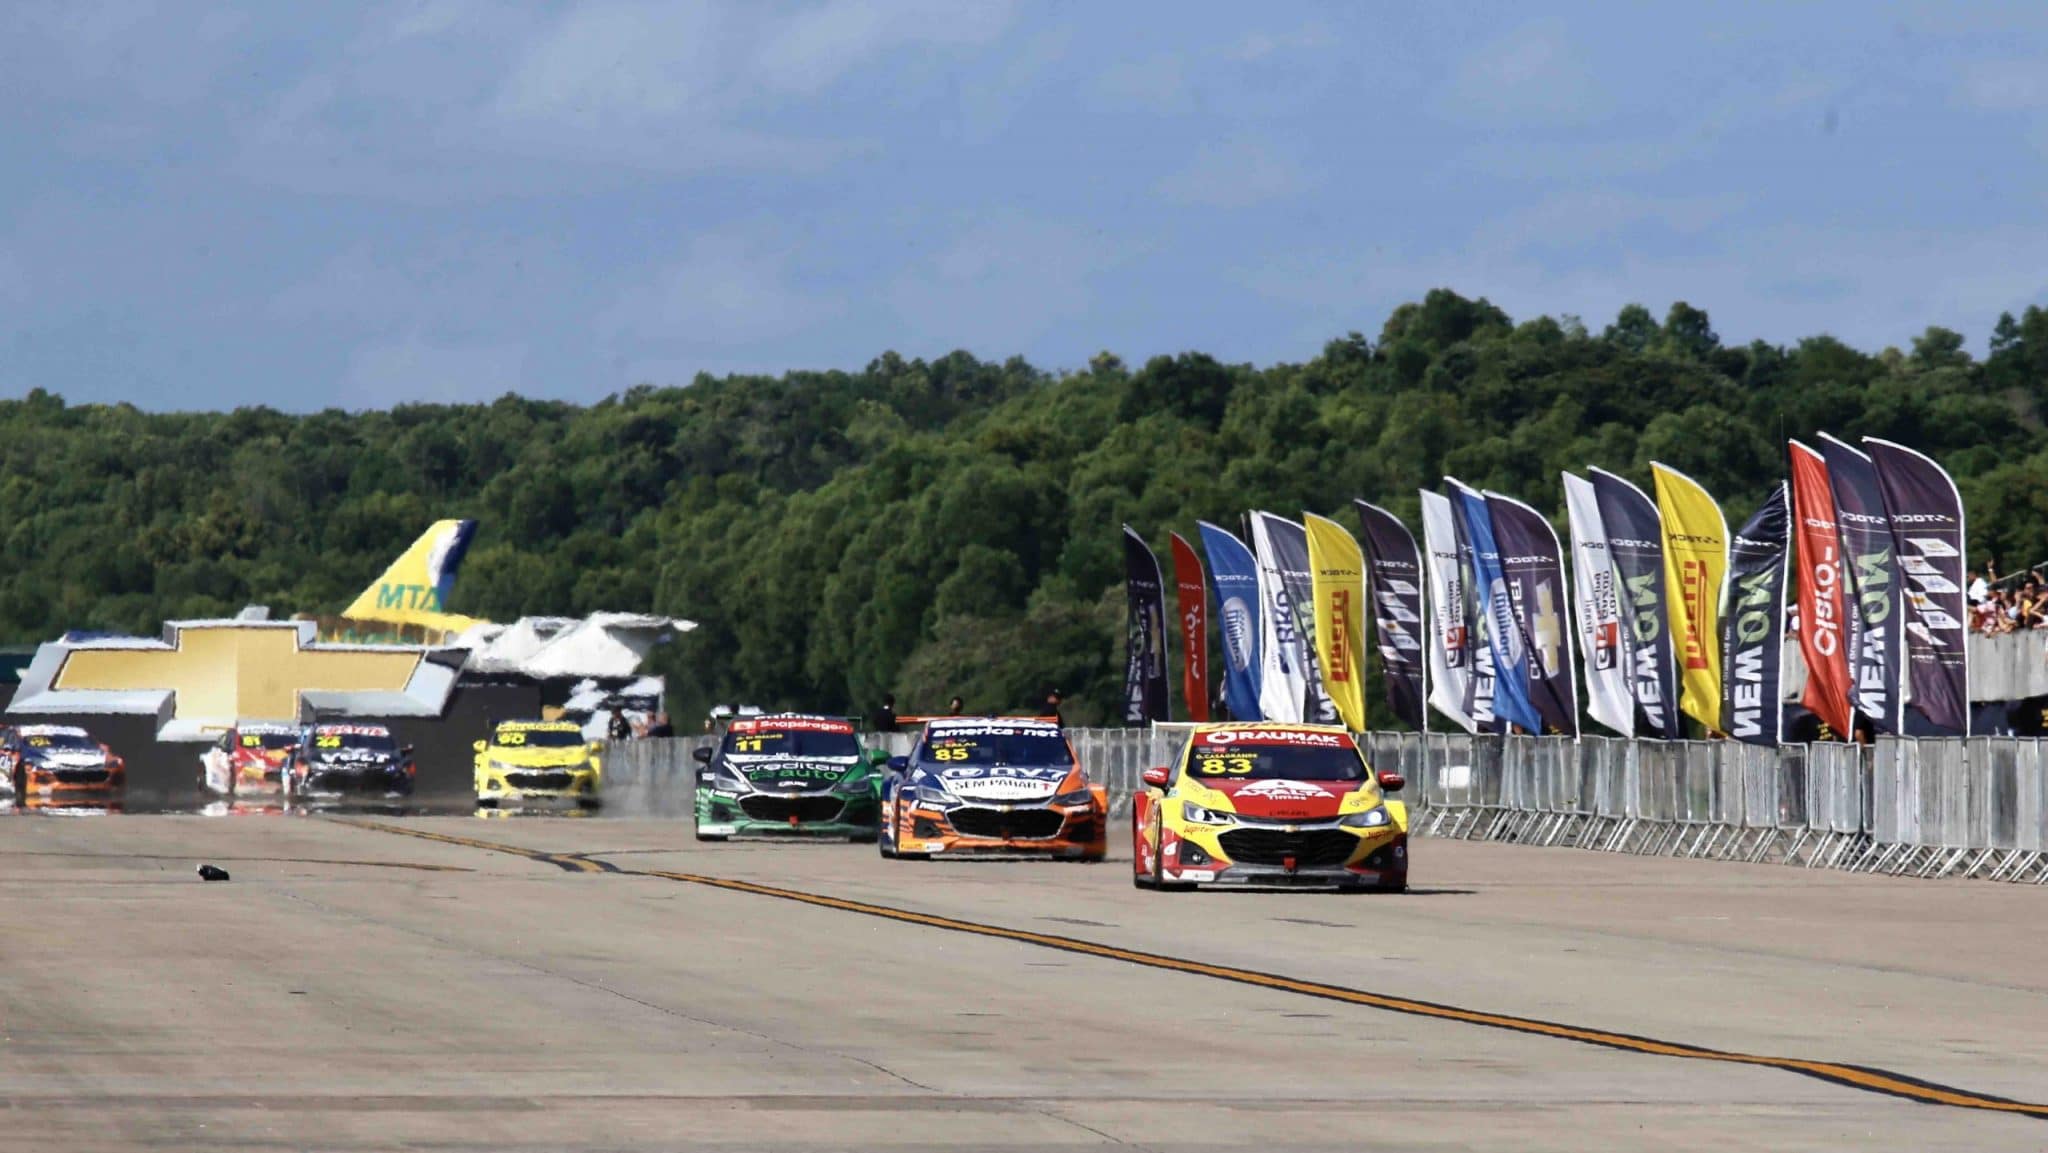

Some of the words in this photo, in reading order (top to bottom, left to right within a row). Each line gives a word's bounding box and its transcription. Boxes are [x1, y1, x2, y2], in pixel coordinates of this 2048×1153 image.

[377, 584, 443, 612] MTA
[760, 720, 848, 731] Snapdragon
[1238, 731, 1340, 743] RAUMAK
[736, 740, 761, 751] 11
[935, 748, 968, 760] 85
[741, 762, 846, 772] creditas
[1201, 759, 1252, 774] 83
[779, 769, 839, 780] auto
